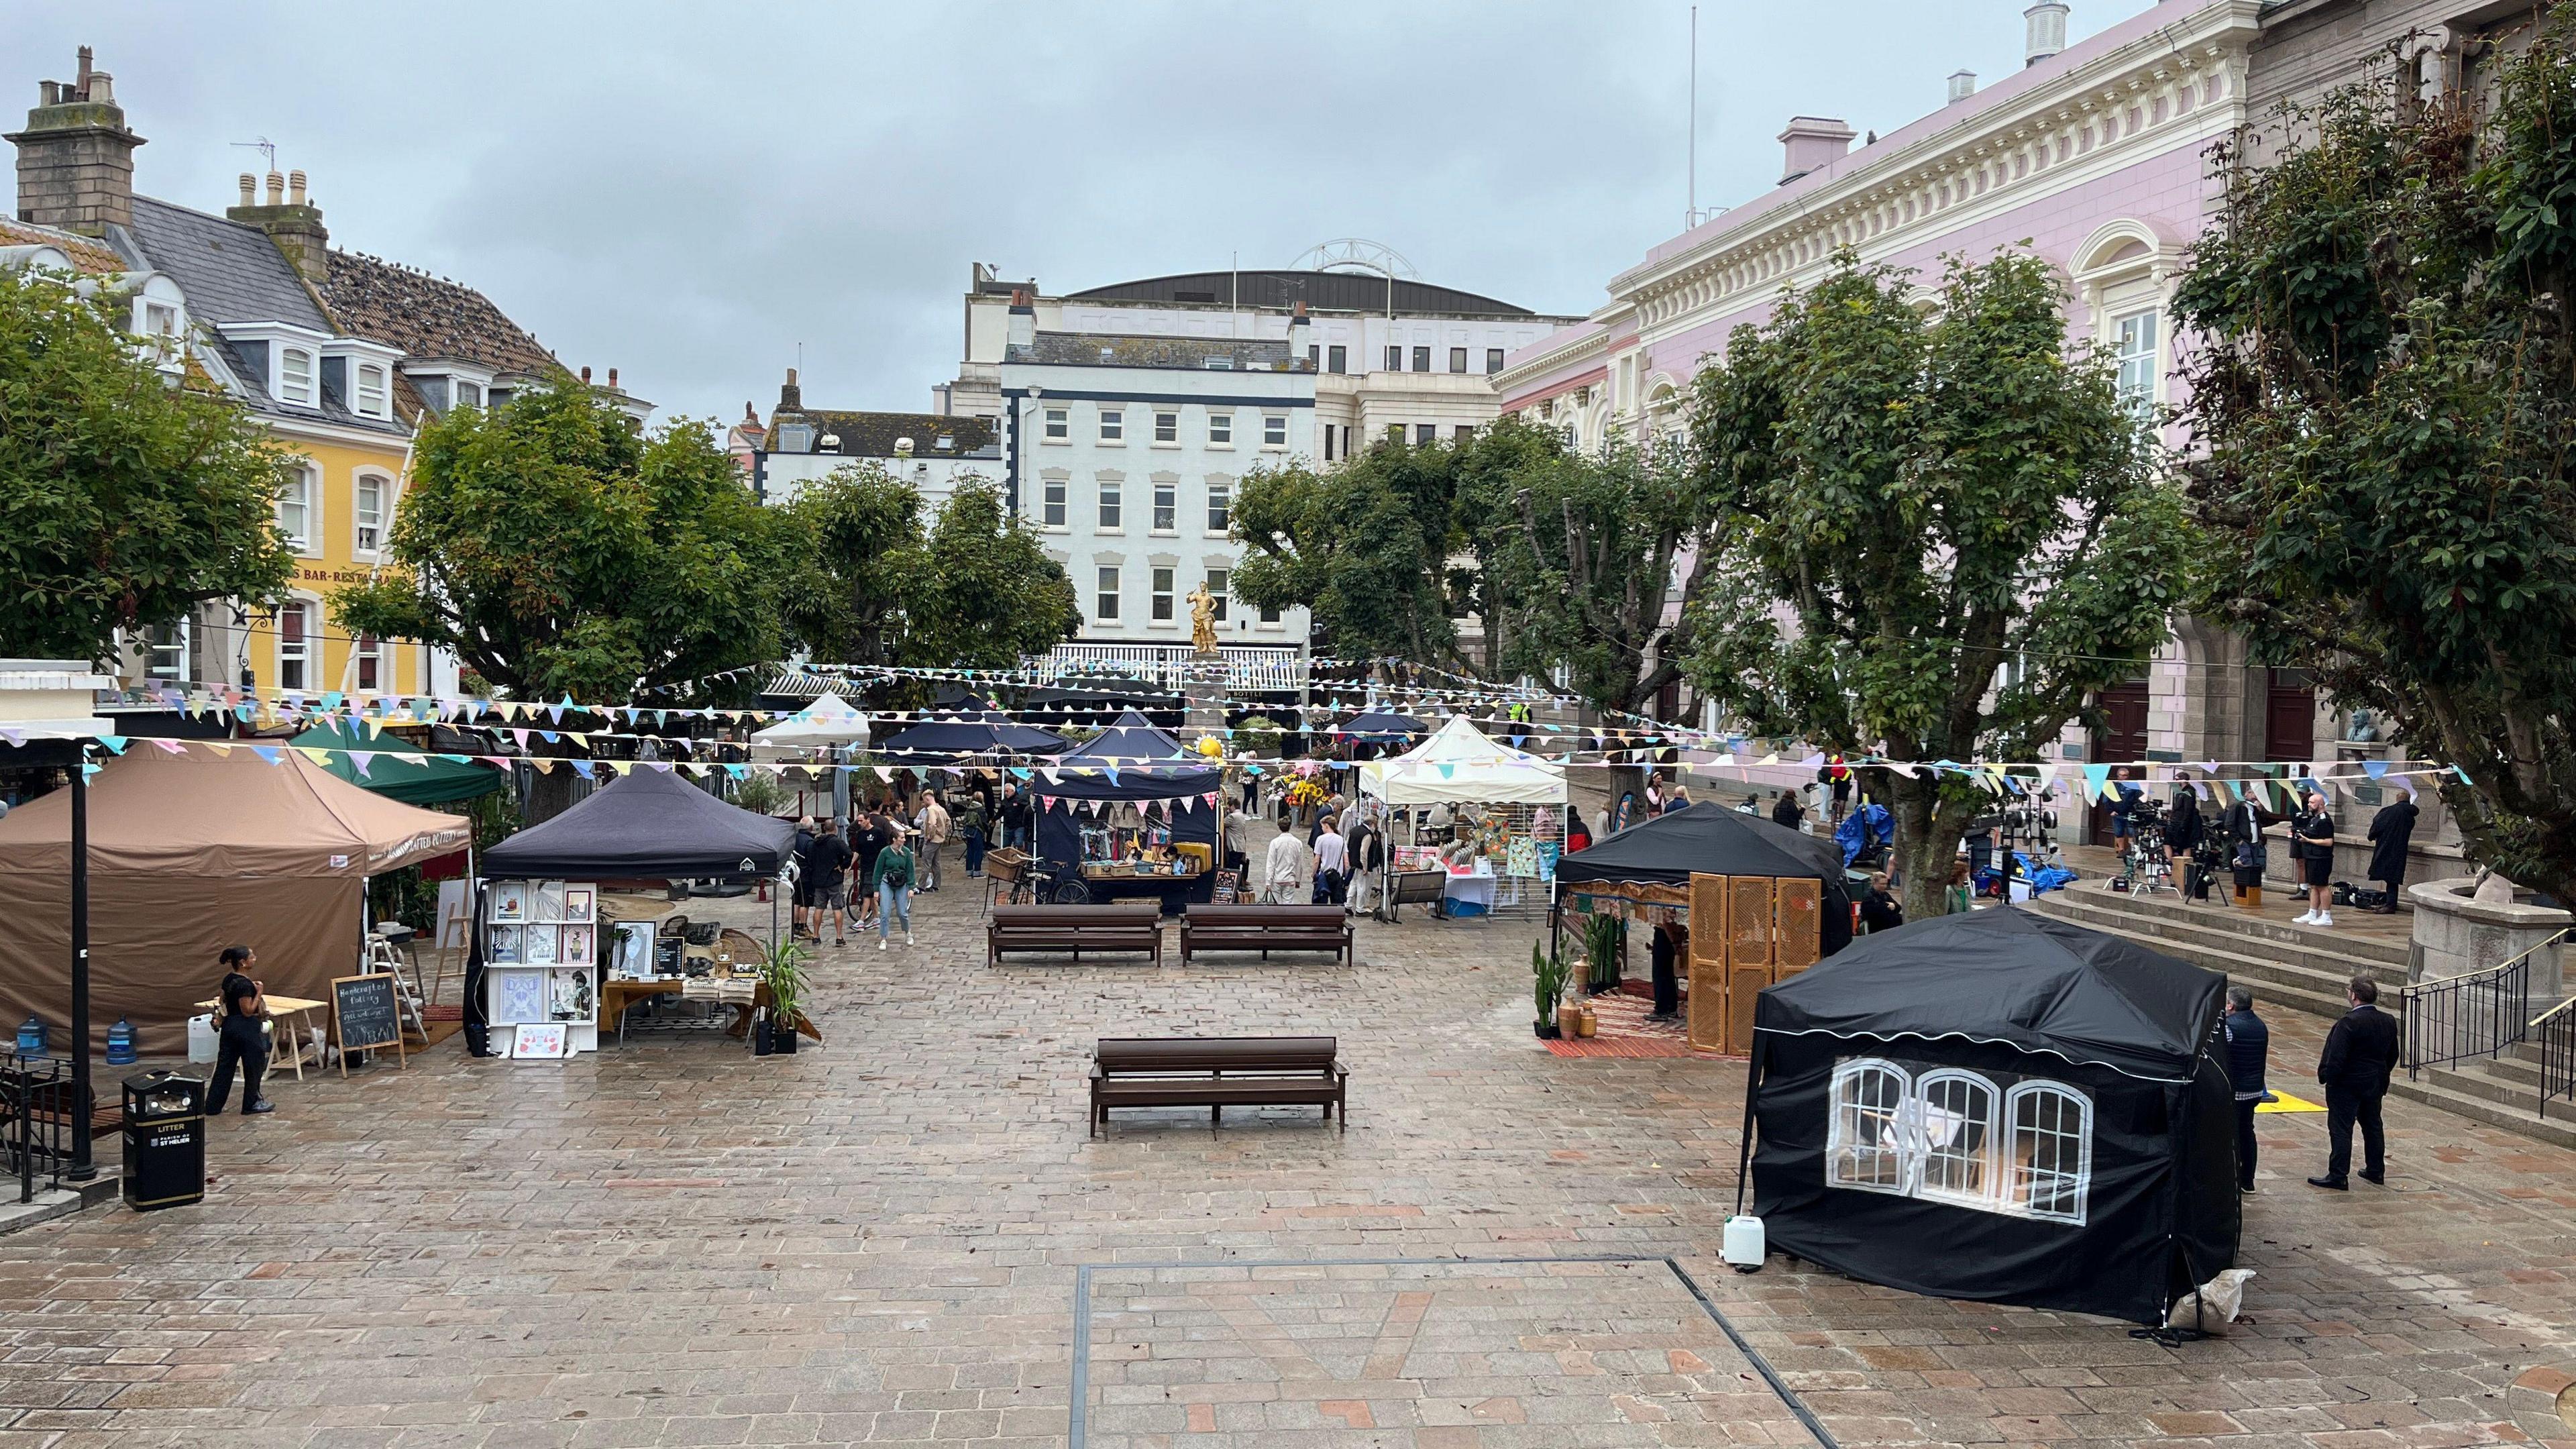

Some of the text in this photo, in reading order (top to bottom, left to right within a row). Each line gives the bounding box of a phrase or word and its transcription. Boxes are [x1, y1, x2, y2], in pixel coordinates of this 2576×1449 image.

[432, 830, 456, 847] POTTERY
[339, 981, 386, 998] Handcrafted
[158, 1123, 184, 1133] LITTER
